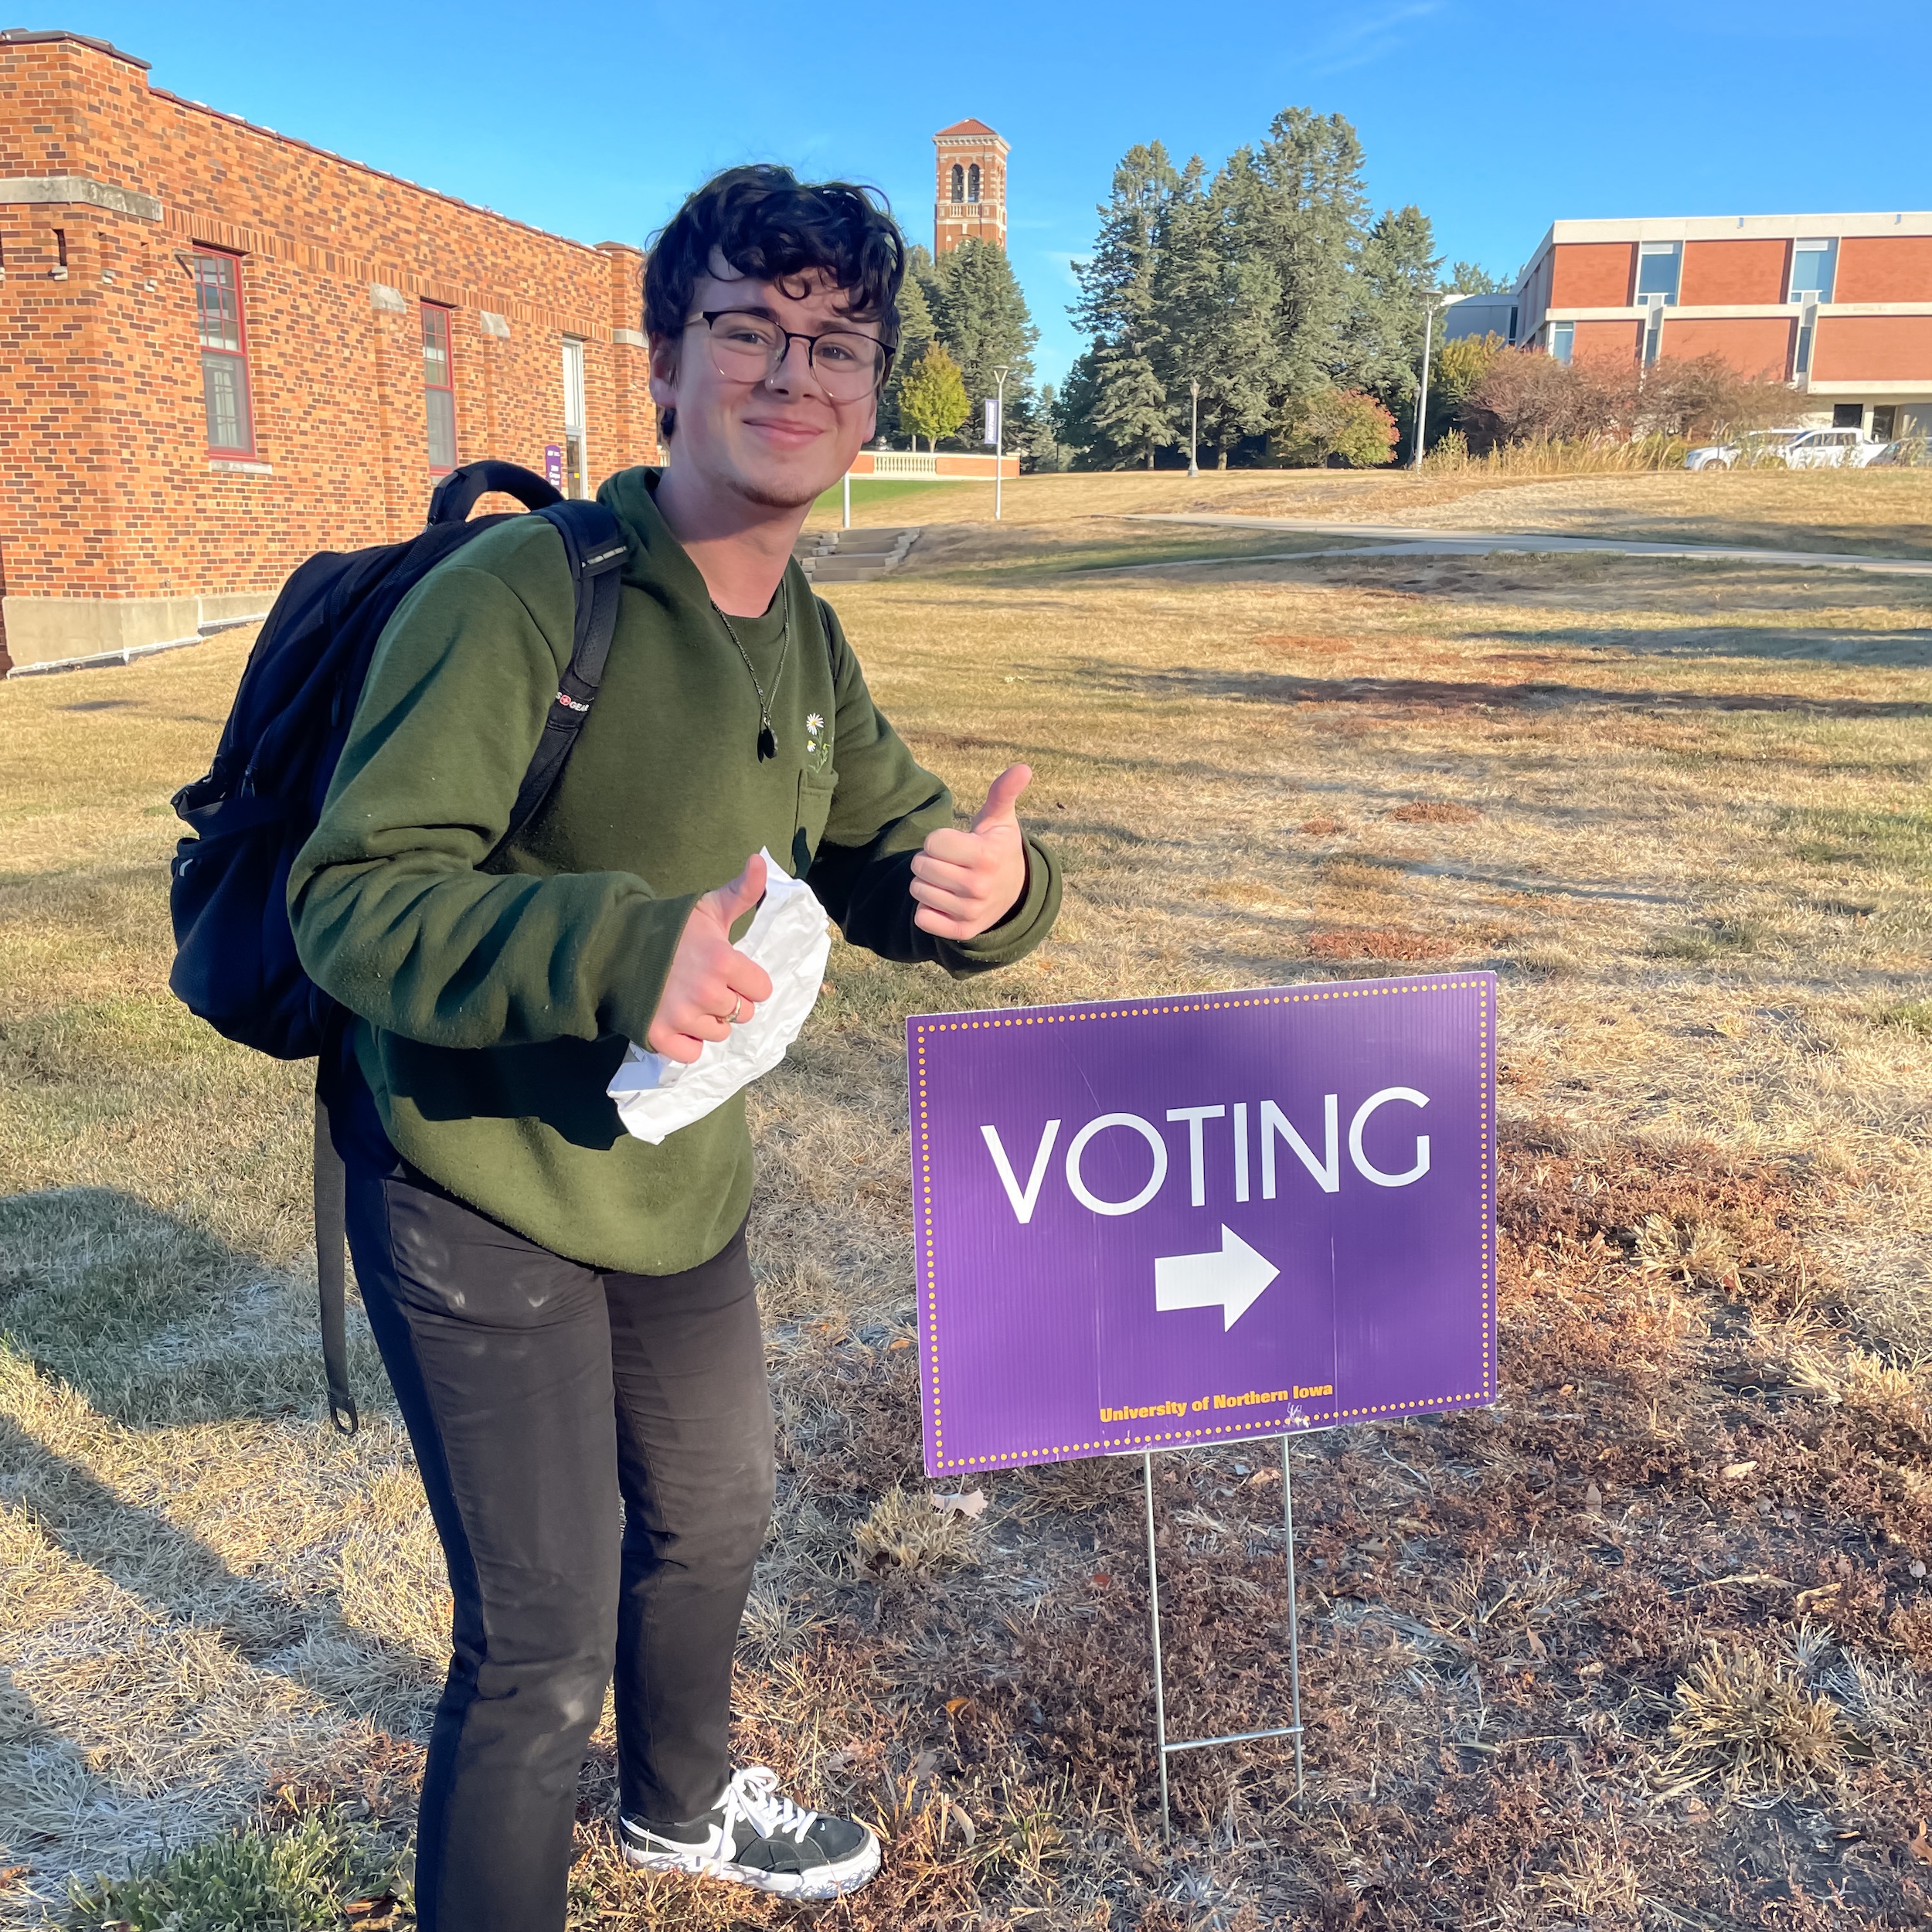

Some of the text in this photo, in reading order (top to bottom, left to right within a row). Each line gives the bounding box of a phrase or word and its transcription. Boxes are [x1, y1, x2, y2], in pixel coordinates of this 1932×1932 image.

[980, 1087, 1430, 1224] VOTING
[1100, 1384, 1333, 1423] University of Northern Iowa
